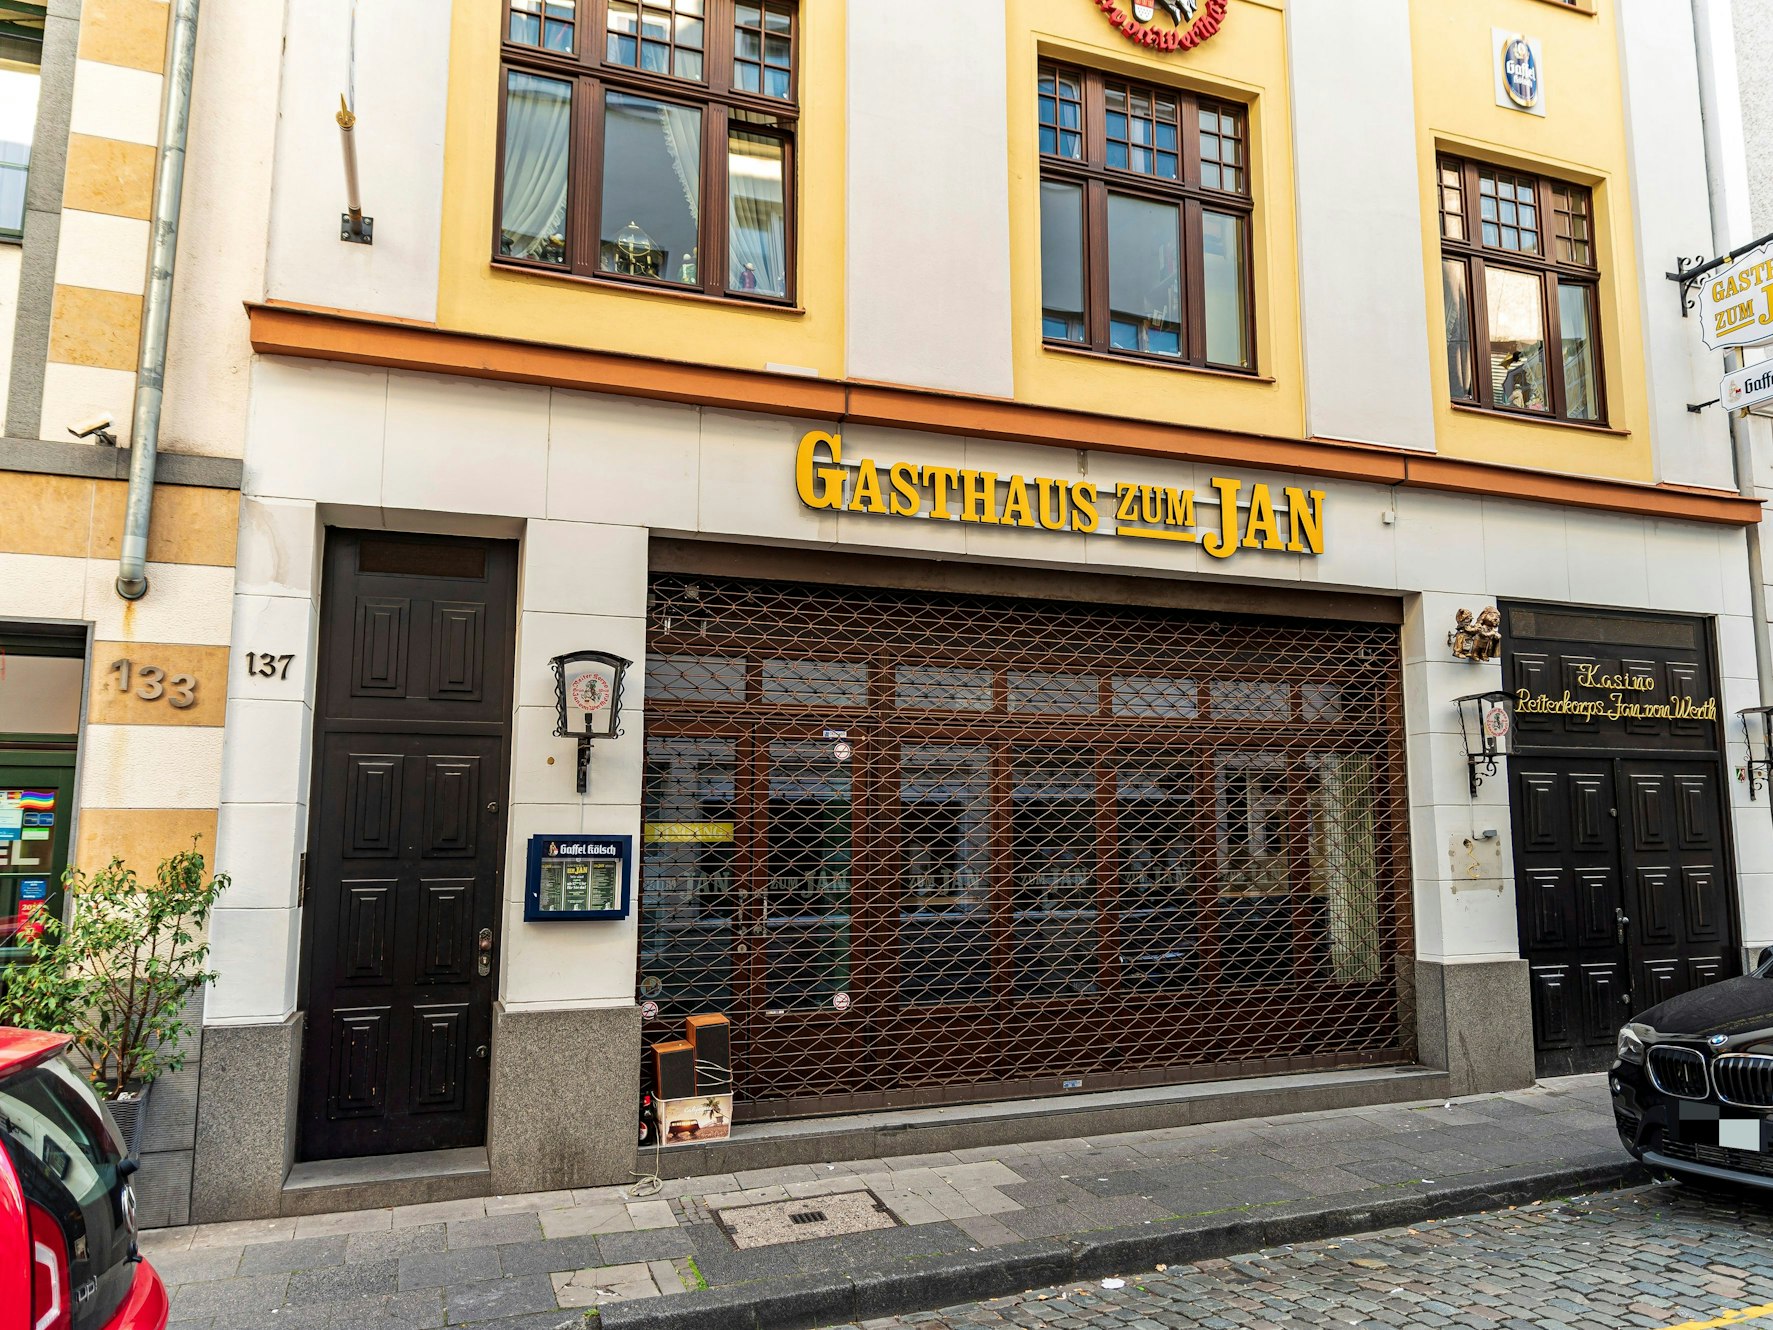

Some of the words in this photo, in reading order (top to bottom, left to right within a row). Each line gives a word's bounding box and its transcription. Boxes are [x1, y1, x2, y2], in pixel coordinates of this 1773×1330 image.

[1714, 299, 1755, 332] ZUM
[795, 430, 1100, 534] GASTHAUS
[1114, 482, 1196, 528] ZUM
[1202, 476, 1327, 560] JAN
[245, 651, 296, 681] 137
[1578, 663, 1655, 691] Kasino
[111, 658, 197, 708] 133
[1514, 688, 1605, 722] Reiterkorps
[1607, 692, 1642, 721] Jan
[1641, 702, 1672, 720] von
[1671, 695, 1717, 721] Werth
[560, 844, 586, 855] Gaffel
[587, 844, 616, 856] Kölsch
[679, 871, 730, 900] JAN
[78, 1274, 98, 1302] up!
